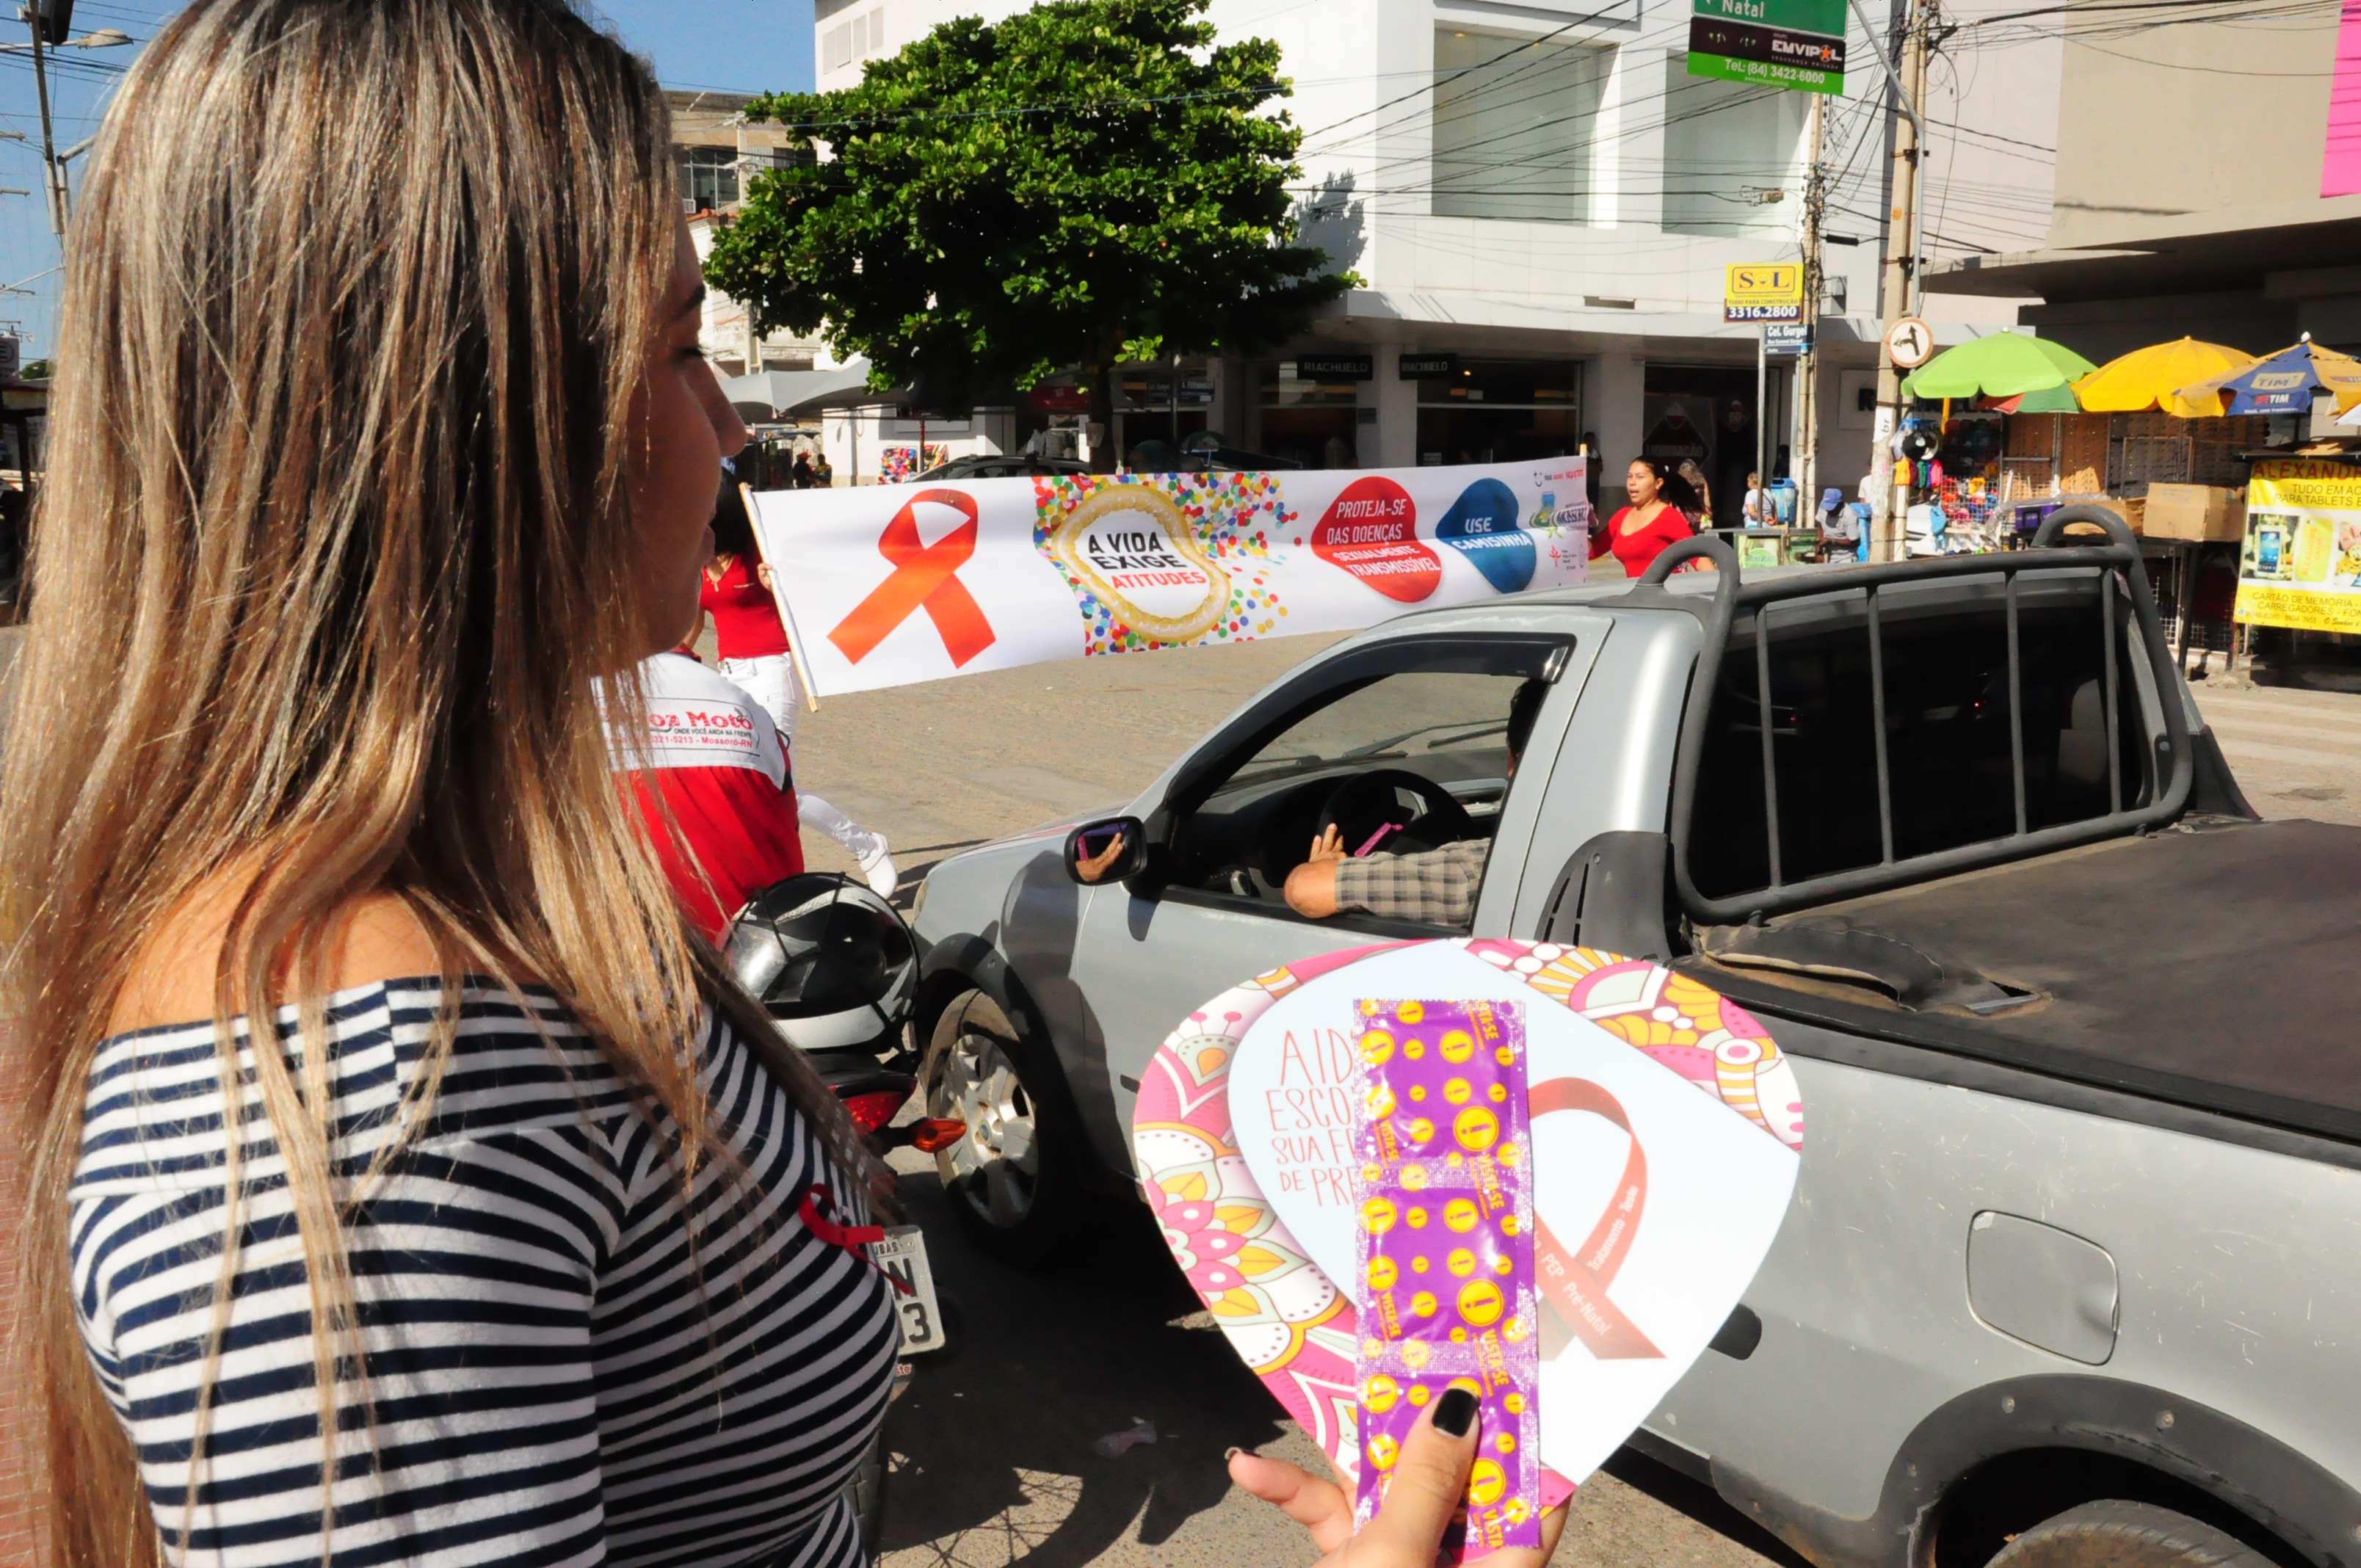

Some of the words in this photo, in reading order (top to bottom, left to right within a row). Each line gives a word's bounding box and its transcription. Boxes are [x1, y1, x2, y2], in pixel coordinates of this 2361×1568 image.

[1722, 1, 1764, 18] Natal
[1747, 62, 1768, 77] (84)
[1728, 306, 1797, 319] 3316.2800
[1767, 326, 1782, 337] Cel.
[1783, 325, 1807, 338] Gurgel
[1304, 361, 1368, 373] RIACHUELO
[1402, 360, 1448, 372] RIACHUELO
[2259, 378, 2290, 387] TIM
[2269, 394, 2290, 404] TIM
[2292, 484, 2323, 494] TUDO
[2326, 485, 2343, 495] EM
[1336, 498, 1407, 518] PROTEJA-SE
[2274, 493, 2302, 504] PARA
[2306, 495, 2354, 506] TABLETS
[1327, 527, 1349, 545] DAS
[1352, 523, 1403, 545] DOENÇAS
[1465, 518, 1493, 534] USE
[1089, 534, 1105, 553] A
[1107, 531, 1164, 553] VIDA
[1451, 534, 1533, 551] CAMISINHA
[1332, 545, 1421, 562] SEXUALMENTE
[1089, 555, 1188, 570] EXIGE
[1346, 556, 1441, 577] TRANSMISSÍVEL
[1111, 571, 1207, 589] ATITUDES
[2252, 592, 2289, 603] CARTÃO
[2291, 595, 2303, 603] DE
[2306, 596, 2353, 607] MEMÓRIA
[2257, 601, 2335, 615] CARREGADORES
[685, 711, 753, 730] Moto
[691, 727, 708, 735] VOCÊ
[650, 736, 694, 744] 321-5213
[702, 736, 752, 748] Mossoró-RN
[1280, 1028, 1355, 1086] AID
[1266, 1086, 1355, 1132] ESCO
[1379, 1119, 1400, 1162] VISTA-SE
[1272, 1135, 1324, 1165] SUA
[1280, 1169, 1306, 1192] DE
[1586, 1218, 1626, 1272] Tratamento
[1619, 1185, 1639, 1213] Teste
[1540, 1253, 1566, 1277] PEP
[1562, 1282, 1613, 1336] Pré-Natal
[1381, 1292, 1402, 1337] VISTA-SE
[1482, 1328, 1510, 1387] VISTA-SE
